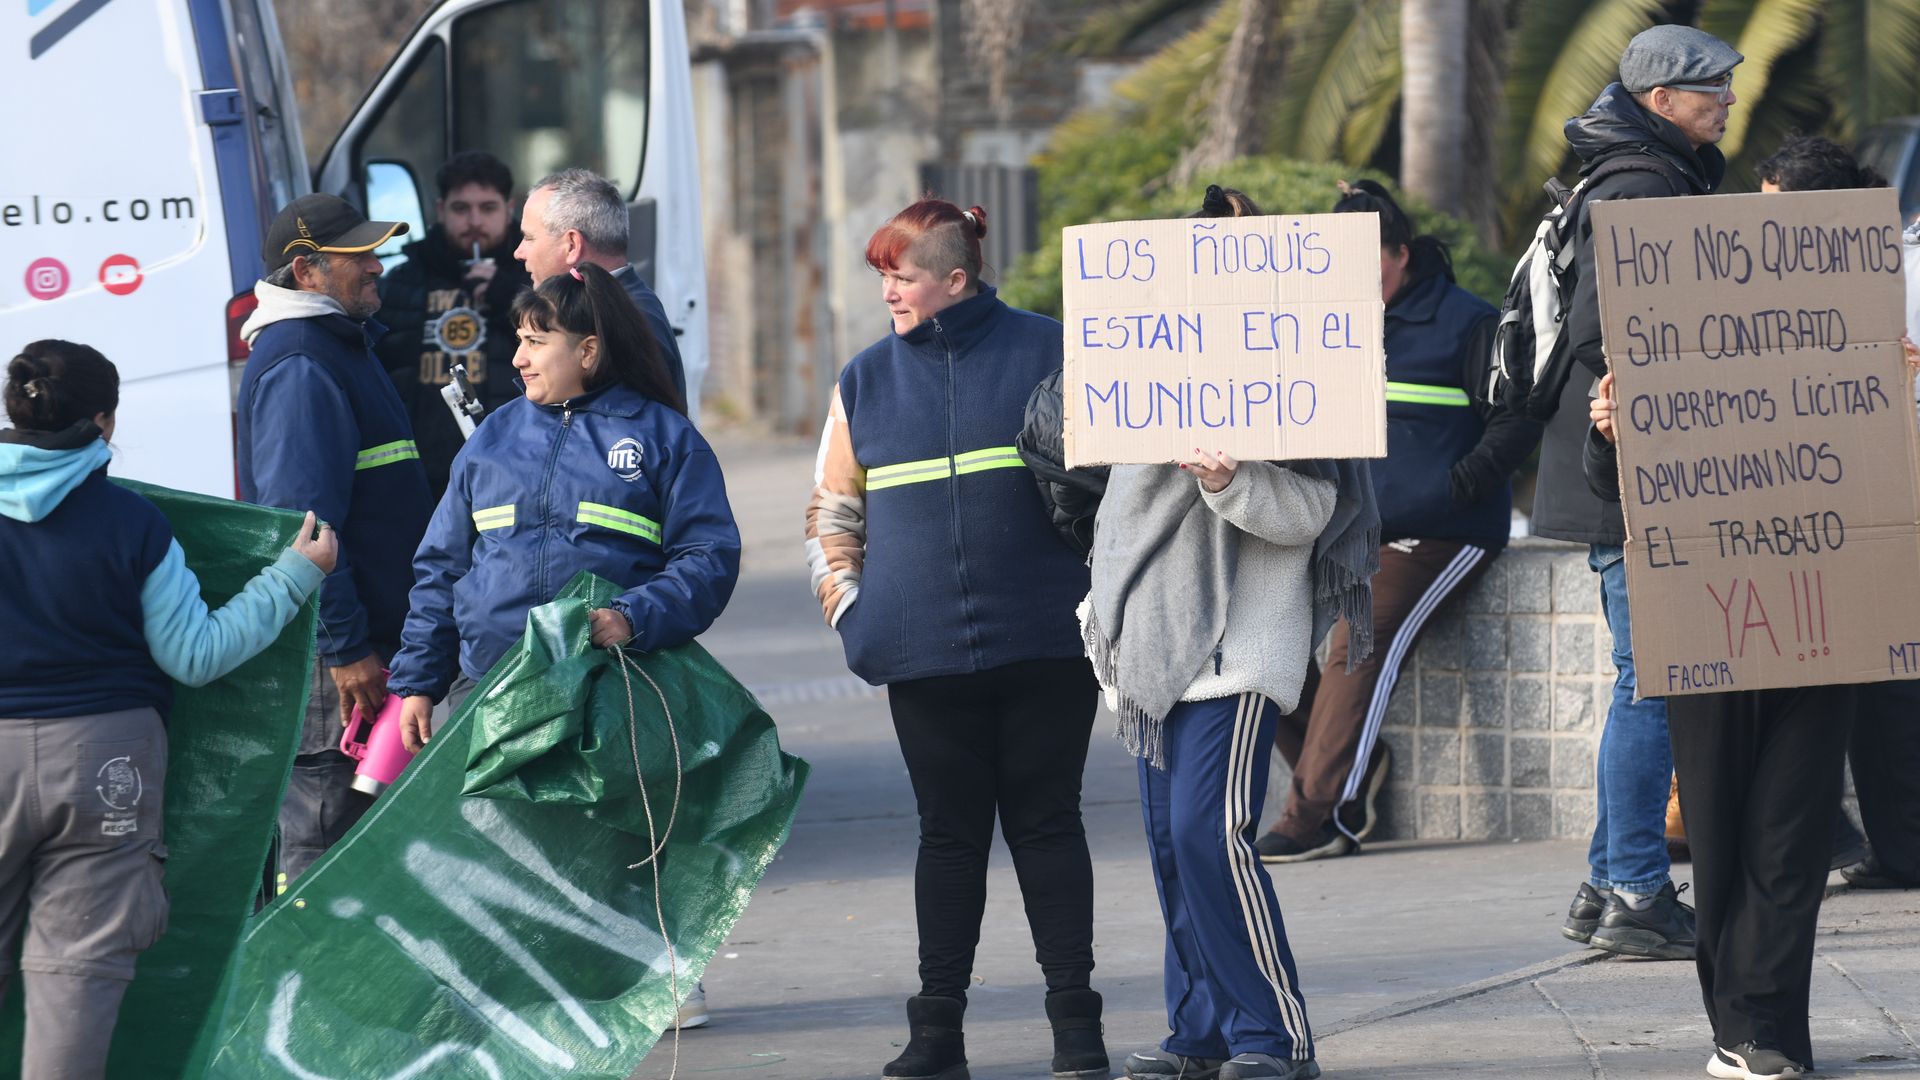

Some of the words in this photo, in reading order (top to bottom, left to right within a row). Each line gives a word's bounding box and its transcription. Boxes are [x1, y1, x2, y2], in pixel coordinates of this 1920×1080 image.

[3, 195, 194, 226] elo.com
[1078, 238, 1155, 282] LOS
[1611, 225, 1673, 287] HOY
[1694, 224, 1752, 284] NOS
[447, 320, 471, 341] 85
[1082, 312, 1203, 354] ESTAN
[1645, 526, 1689, 568] EL
[1709, 510, 1845, 558] TRABAJO
[1667, 661, 1734, 692] FACCYR
[1889, 642, 1920, 675] MT
